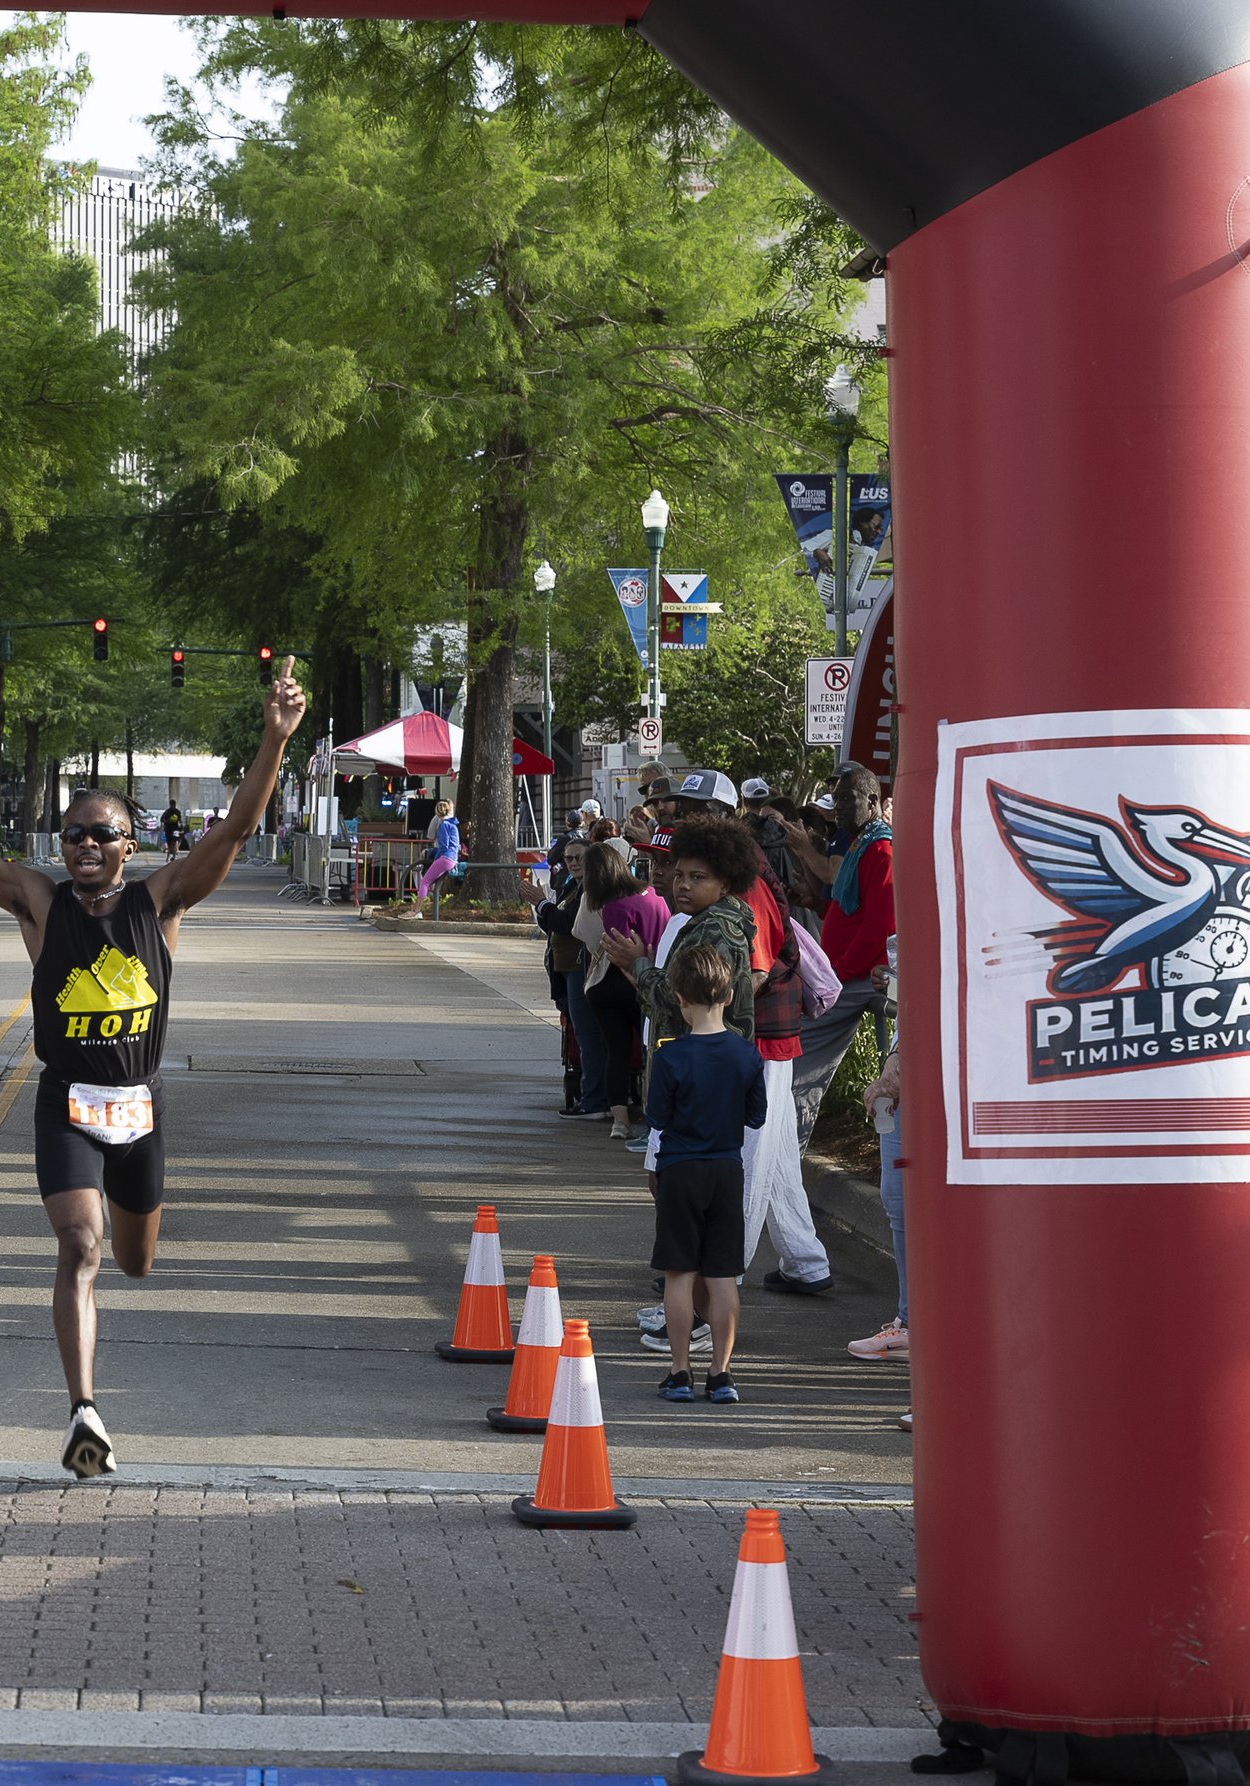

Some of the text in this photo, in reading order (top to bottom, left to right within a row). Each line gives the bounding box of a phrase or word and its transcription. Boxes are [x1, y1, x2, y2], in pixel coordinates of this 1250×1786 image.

[821, 693, 846, 702] FESTIV
[91, 944, 110, 975] Over
[55, 966, 82, 1006] Health
[1061, 1041, 1159, 1067] TIMING
